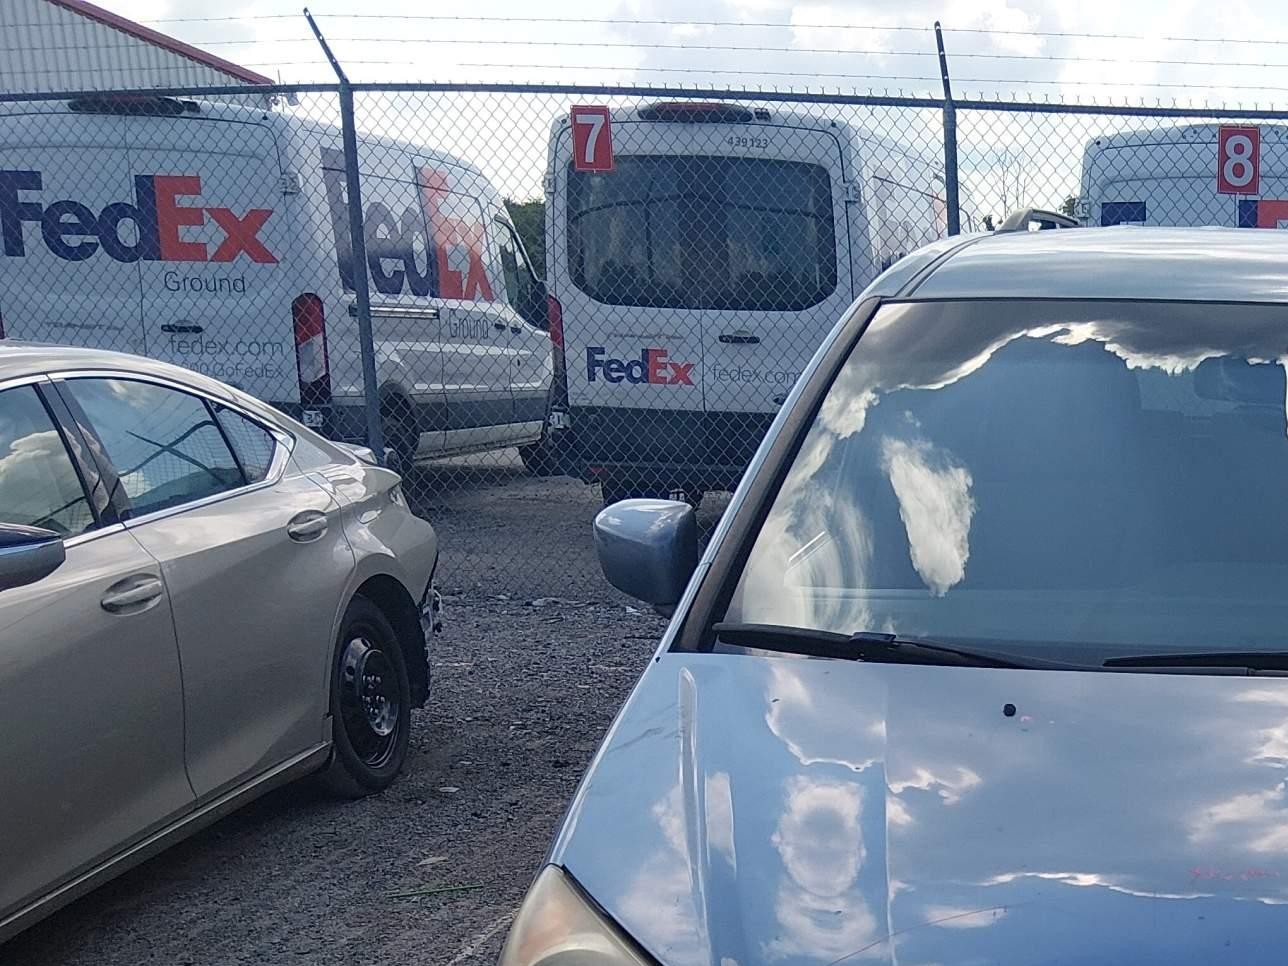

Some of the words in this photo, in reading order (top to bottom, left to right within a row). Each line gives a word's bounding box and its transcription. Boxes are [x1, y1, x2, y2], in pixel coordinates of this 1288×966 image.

[576, 114, 605, 163] 7
[727, 136, 769, 149] 439123
[1225, 135, 1253, 186] 8
[0, 170, 279, 263] FedEx
[320, 147, 496, 302] FedEx
[164, 271, 246, 294] Ground
[168, 336, 284, 357] fedex.com
[586, 346, 695, 386] FedEx
